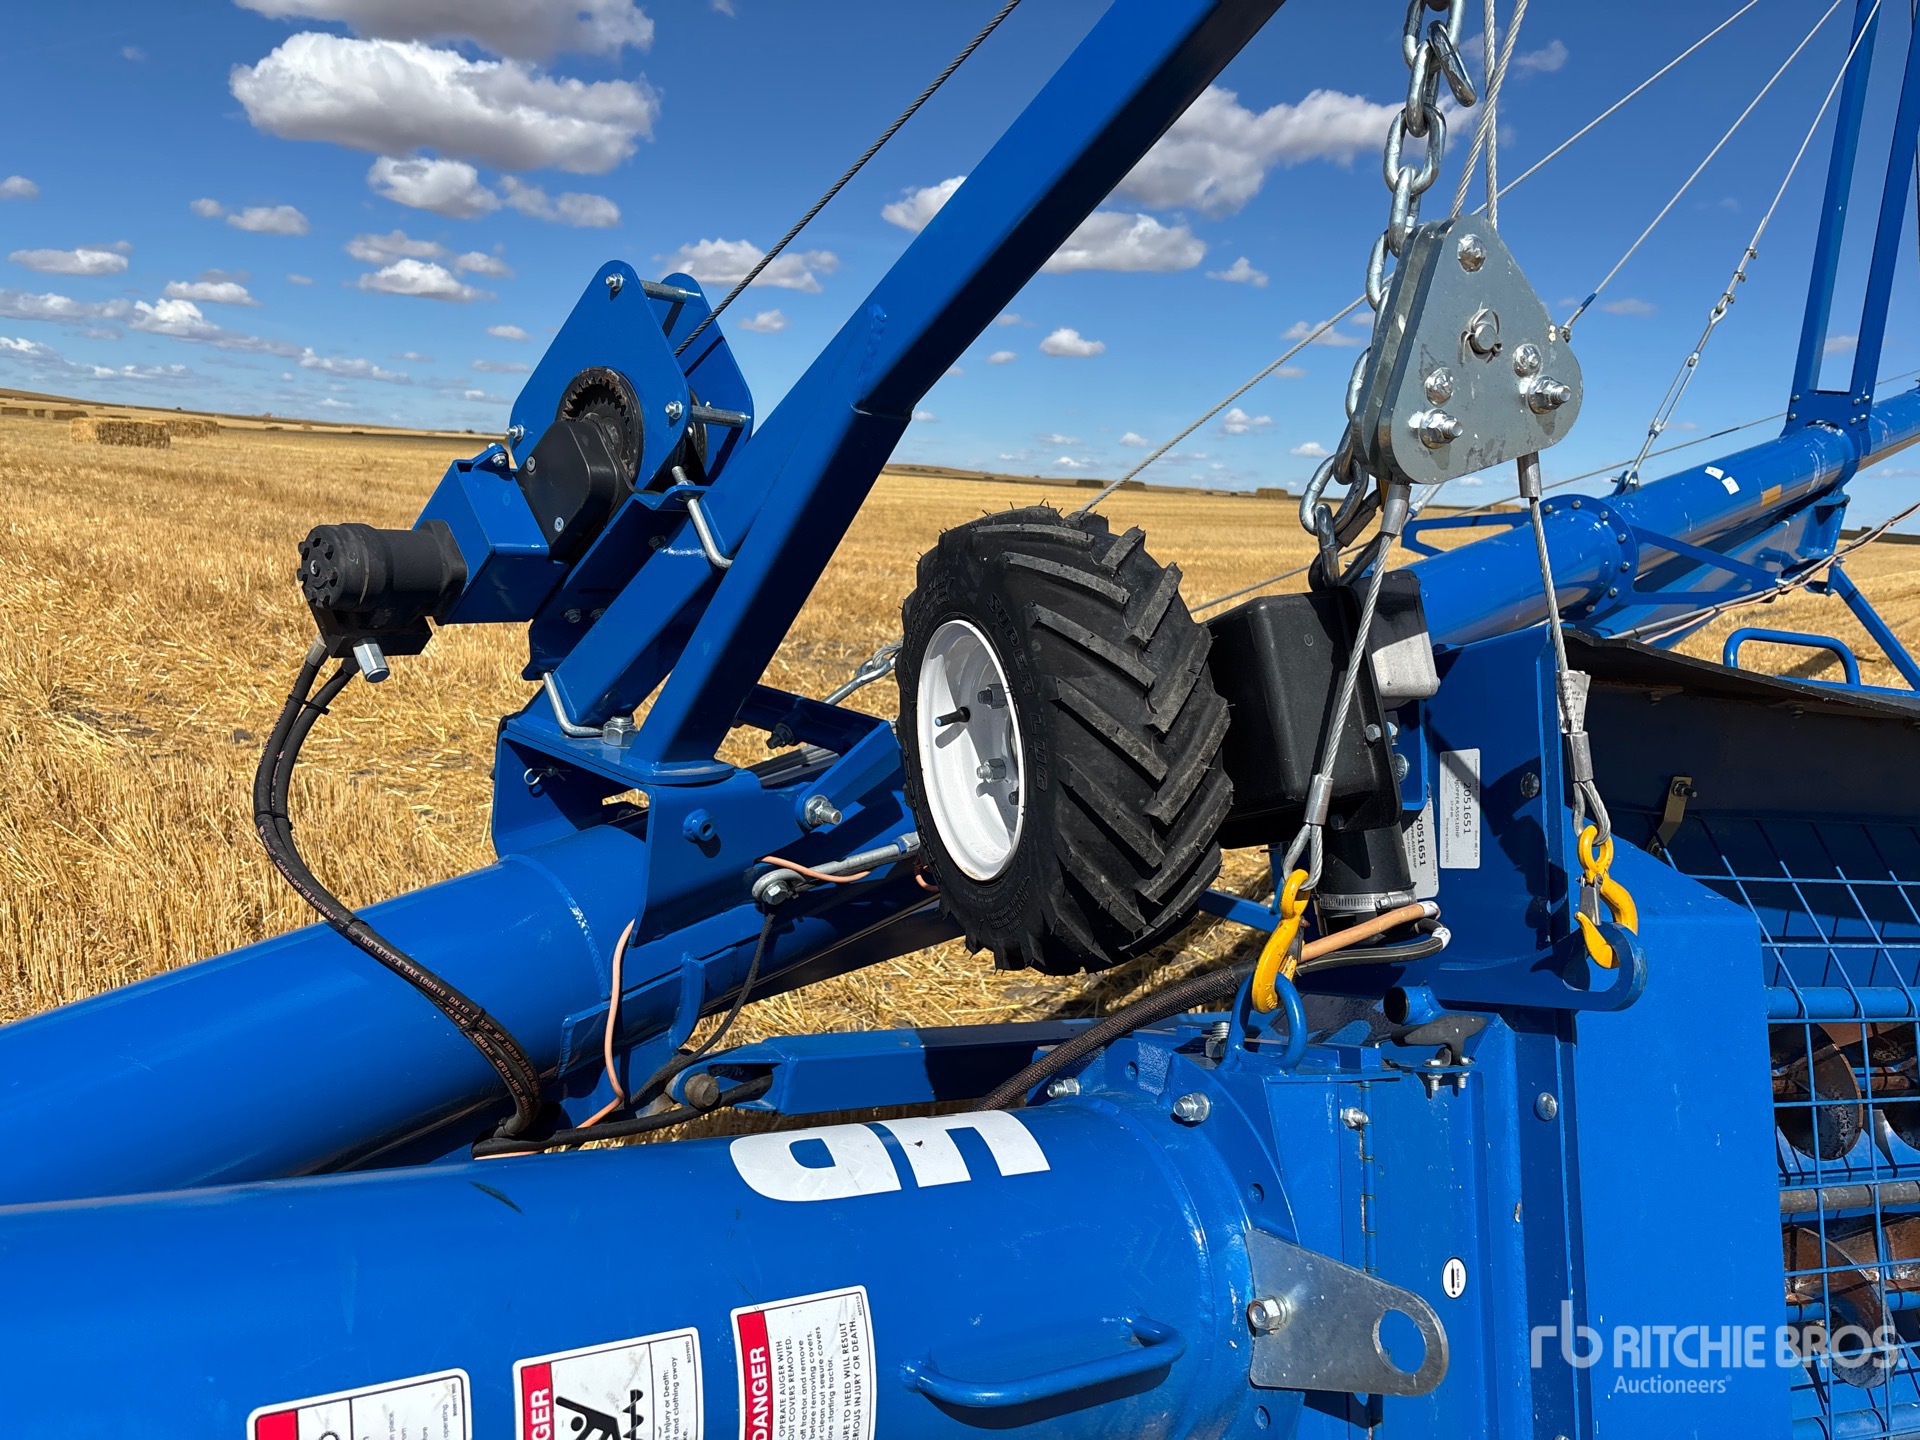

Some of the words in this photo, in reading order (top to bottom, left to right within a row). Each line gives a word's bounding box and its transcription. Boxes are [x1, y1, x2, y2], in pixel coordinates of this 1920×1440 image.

[985, 592, 1034, 698] SUPER
[1029, 712, 1048, 794] LUG
[1463, 782, 1472, 835] 2051651
[1416, 816, 1426, 867] 2051651
[403, 964, 419, 979] SAE
[448, 996, 460, 1008] DN
[775, 1341, 785, 1363] WITH
[815, 1326, 825, 1357] covers
[838, 1322, 850, 1354] RESULT
[670, 1357, 679, 1380] away
[785, 1336, 796, 1383] REMOVED.
[798, 1340, 807, 1375] remove
[841, 1357, 851, 1379] WILL
[851, 1355, 860, 1370] OR
[749, 1346, 769, 1440] DANGER
[777, 1365, 787, 1396] AUGER
[808, 1366, 818, 1409] removing
[842, 1381, 852, 1407] HEED
[851, 1373, 862, 1407] INJURY
[671, 1382, 681, 1416] clothing
[788, 1385, 796, 1422] COVERS
[818, 1391, 826, 1406] out
[672, 1417, 680, 1433] and
[778, 1398, 788, 1438] OPERATE
[818, 1407, 826, 1433] clean
[843, 1409, 851, 1423] TO
